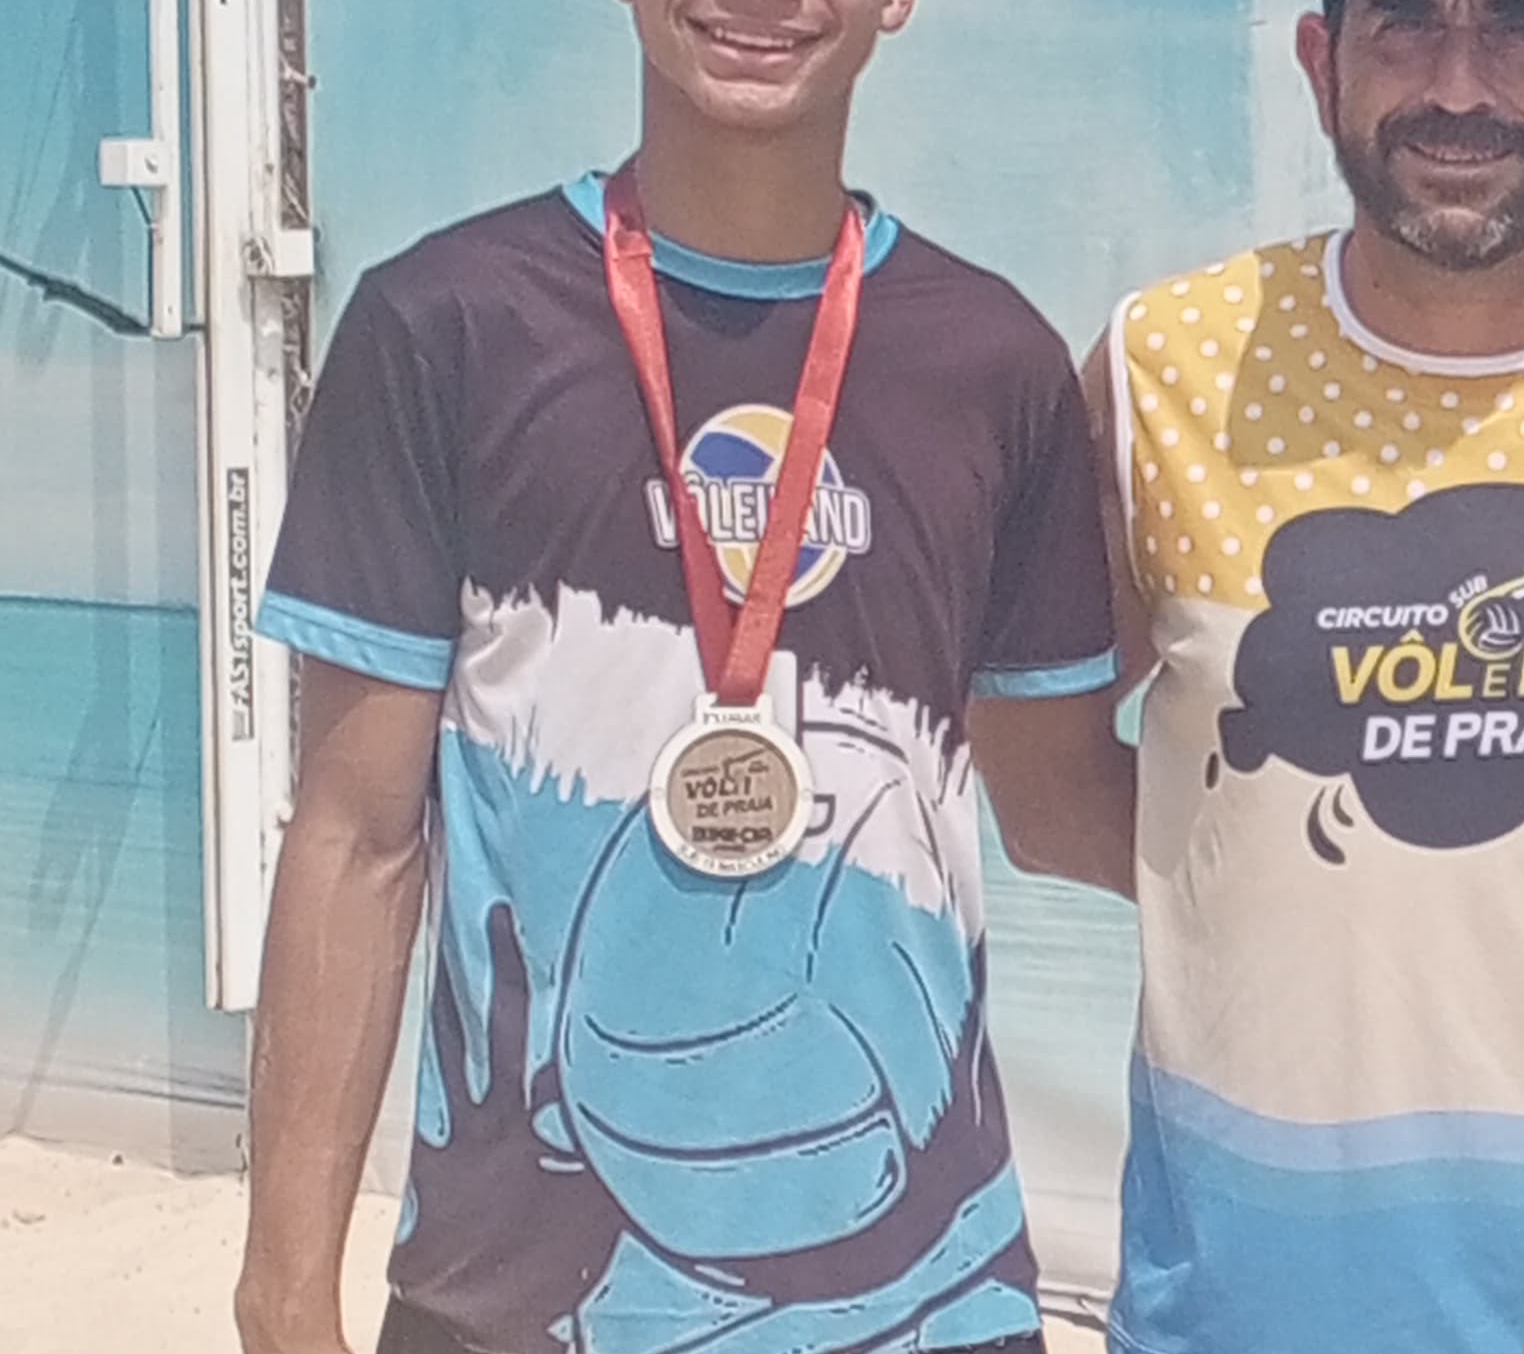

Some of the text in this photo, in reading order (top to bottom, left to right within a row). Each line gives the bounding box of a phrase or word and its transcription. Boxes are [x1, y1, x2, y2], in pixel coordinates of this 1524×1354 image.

[1448, 575, 1488, 609] SUB
[1317, 604, 1449, 630] CIRCUITO
[1362, 715, 1435, 761] DE
